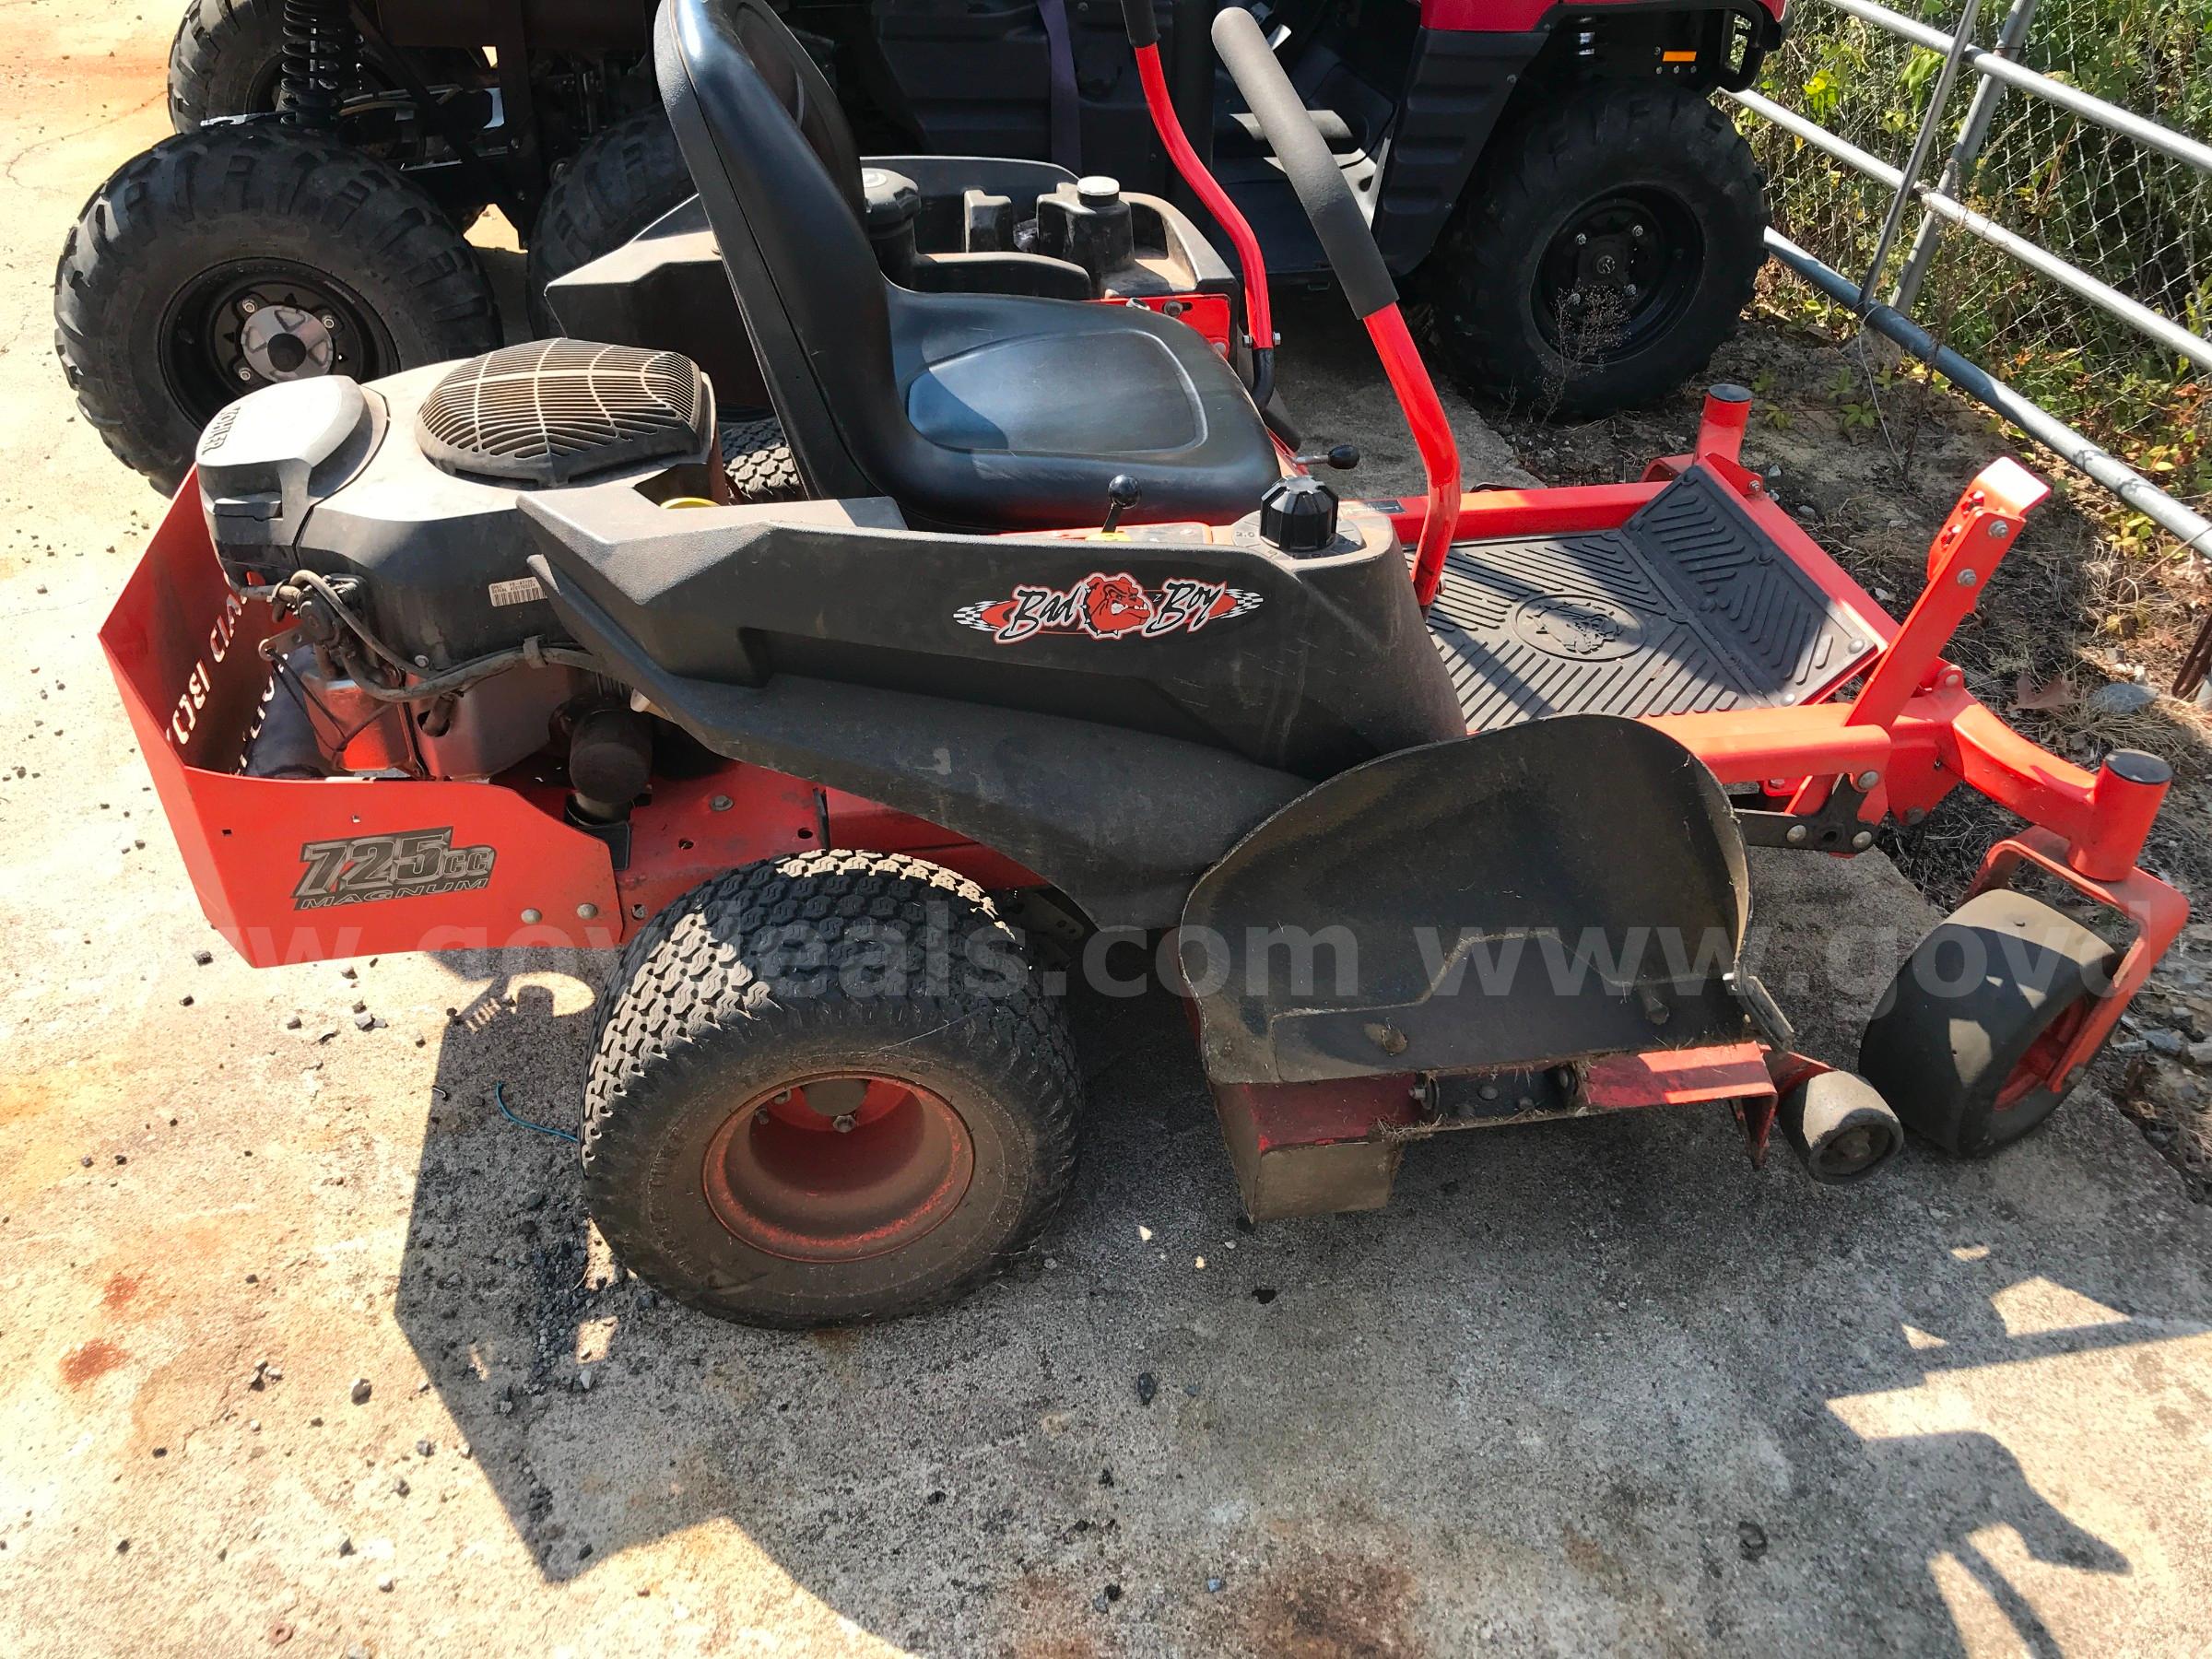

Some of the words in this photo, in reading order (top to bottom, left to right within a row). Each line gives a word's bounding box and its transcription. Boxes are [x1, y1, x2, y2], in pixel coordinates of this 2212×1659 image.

[201, 405, 241, 456] KOHLER
[995, 583, 1086, 642] Bad
[1143, 581, 1226, 635] Boy
[300, 877, 489, 910] MAGNUM
